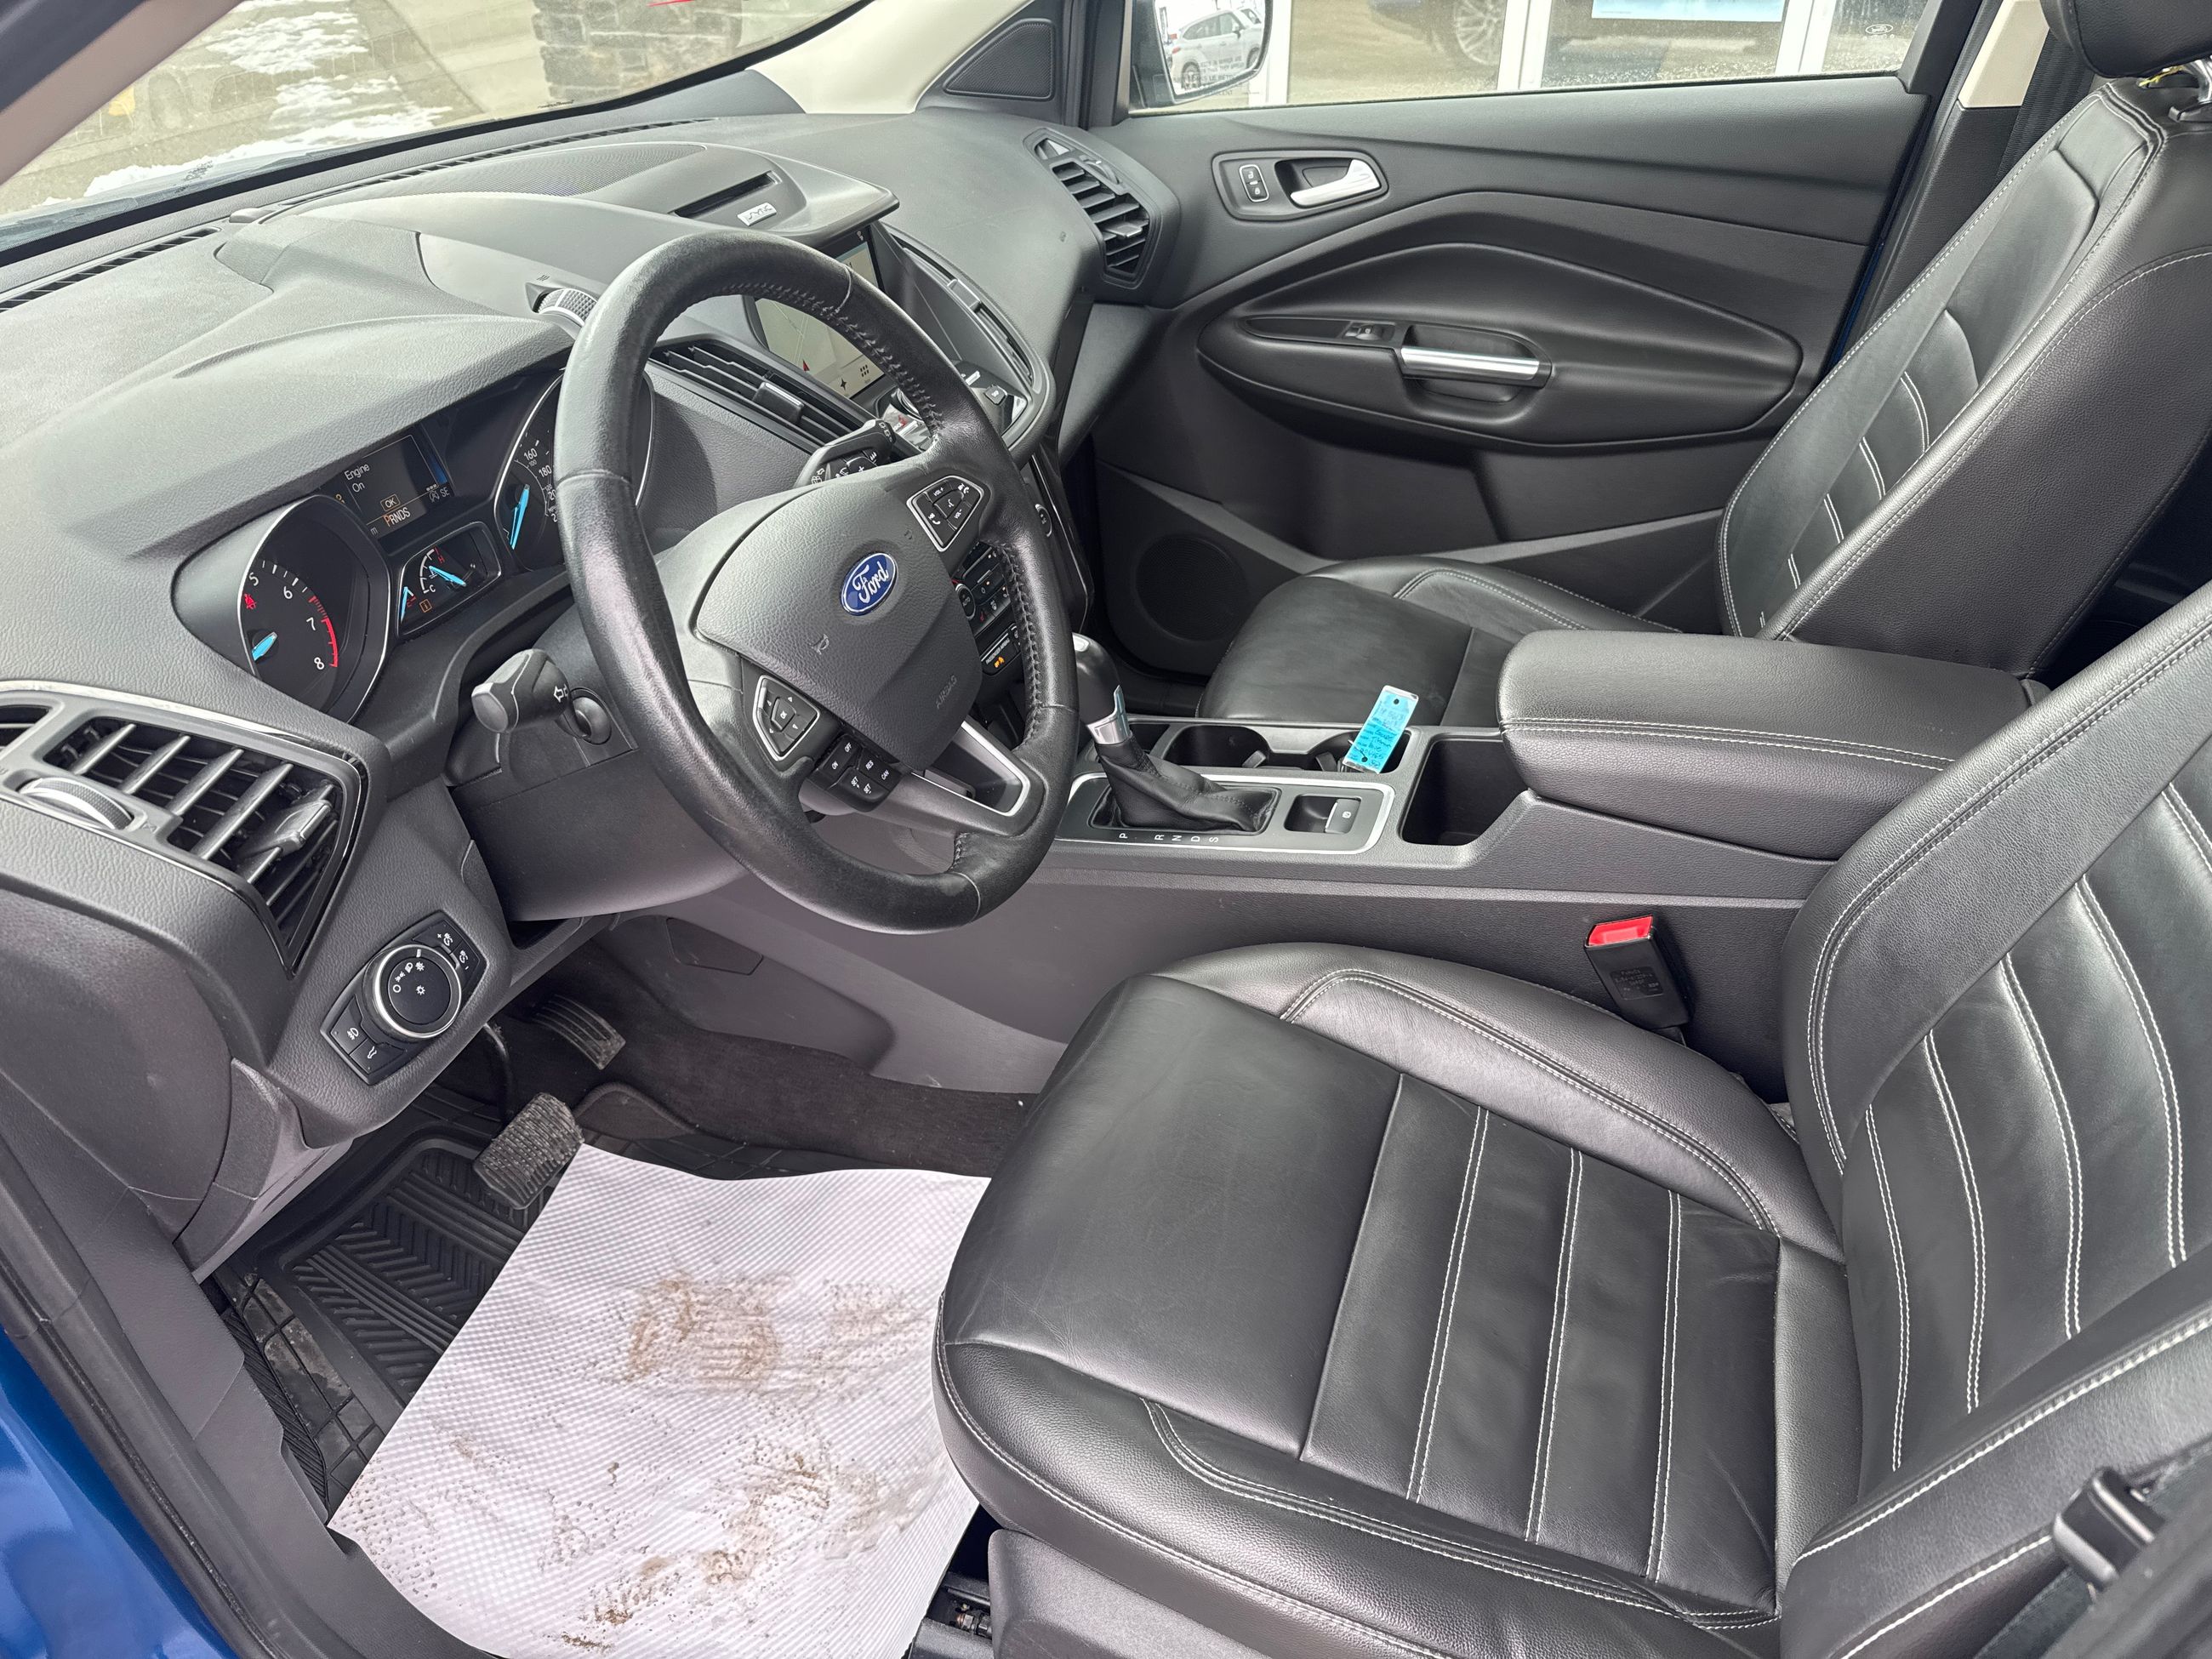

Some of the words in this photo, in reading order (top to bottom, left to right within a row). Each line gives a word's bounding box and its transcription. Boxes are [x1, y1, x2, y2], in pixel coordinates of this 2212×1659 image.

[523, 448, 538, 461] 160
[344, 464, 370, 481] Engine
[539, 465, 552, 478] 180
[351, 482, 366, 493] On
[385, 496, 397, 509] OK
[248, 572, 259, 586] 5
[852, 561, 889, 604] Ford
[283, 585, 294, 600] 6
[429, 584, 436, 593] C
[306, 617, 316, 630] 7
[313, 657, 325, 670] 8
[844, 742, 852, 753] OFF
[831, 761, 839, 770] ON
[865, 760, 875, 770] RES
[881, 769, 890, 780] CAN
